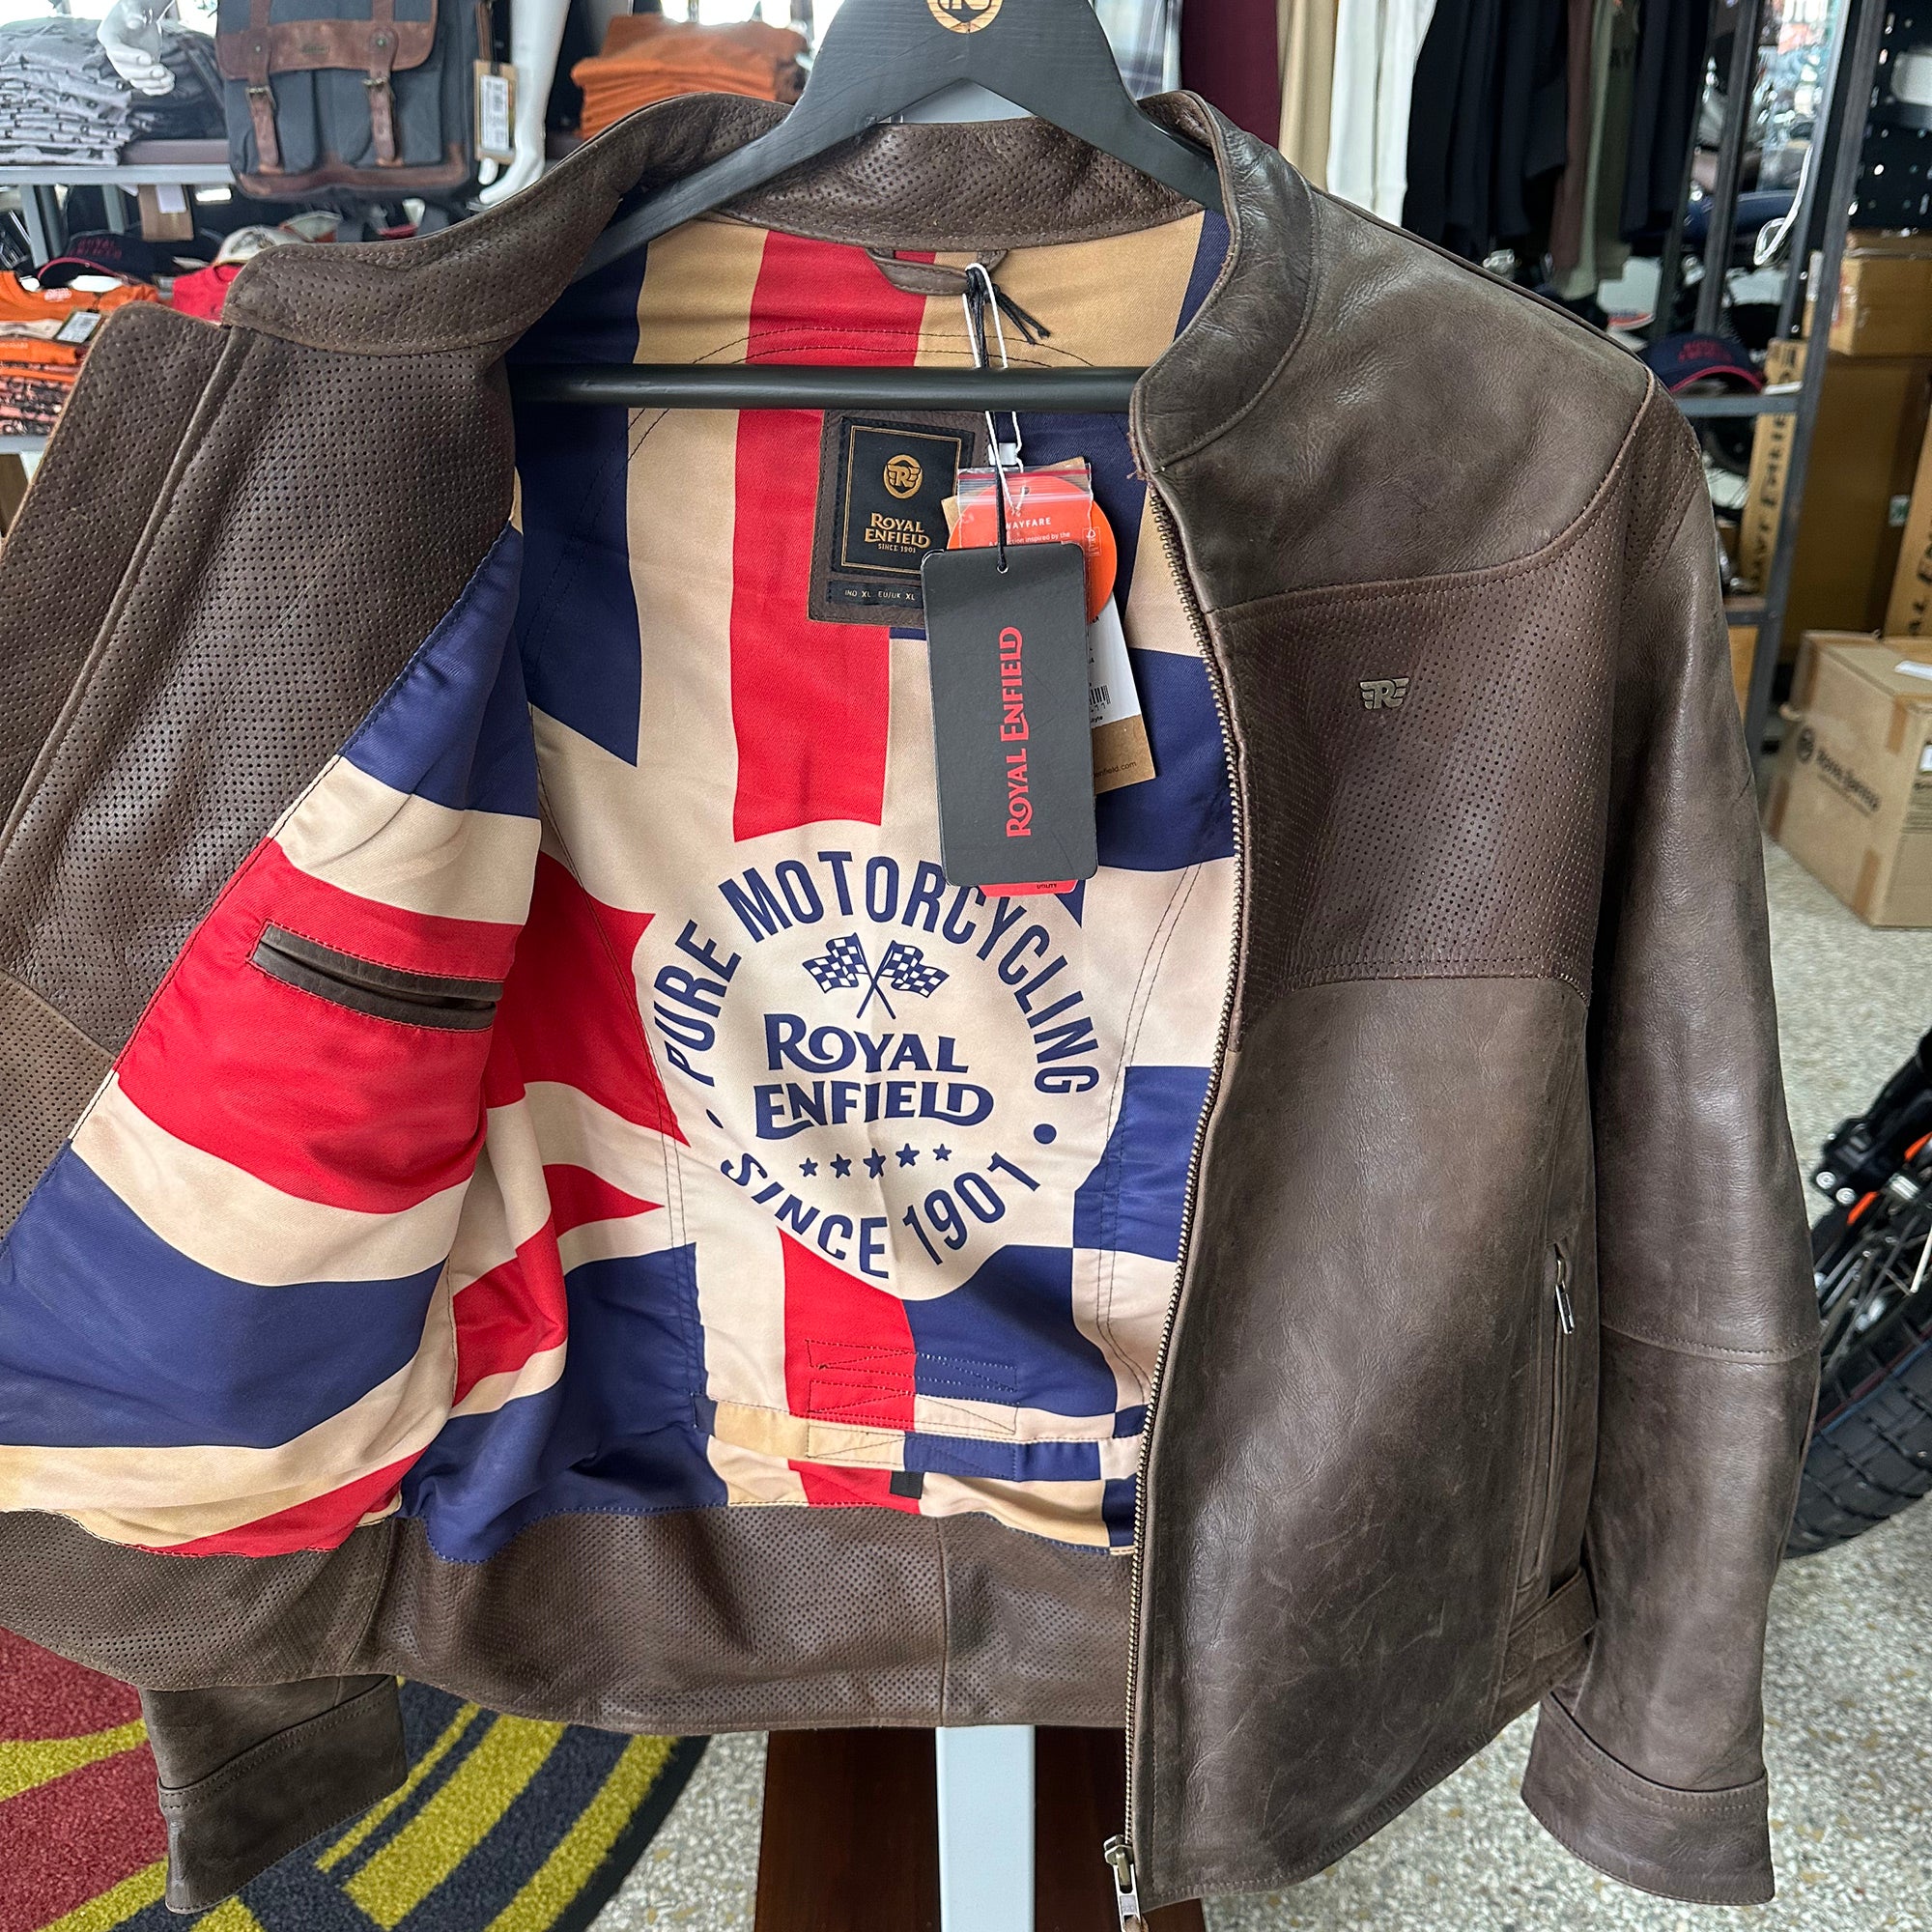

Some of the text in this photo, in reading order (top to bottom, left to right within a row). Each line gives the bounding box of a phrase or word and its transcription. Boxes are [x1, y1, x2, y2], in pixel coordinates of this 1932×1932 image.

[864, 527, 931, 549] ENFIELD
[870, 512, 924, 533] ROYAL
[878, 543, 898, 552] SINCE
[1025, 533, 1050, 543] inspired
[1060, 530, 1071, 539] the
[998, 626, 1033, 838] ROYAL ENFIELD
[654, 851, 1100, 1094] PURE MOTORCYCLING
[764, 1014, 969, 1074] ROYAL
[753, 1080, 994, 1141] ENFIELD
[720, 1151, 1041, 1279] SINCE 1901
